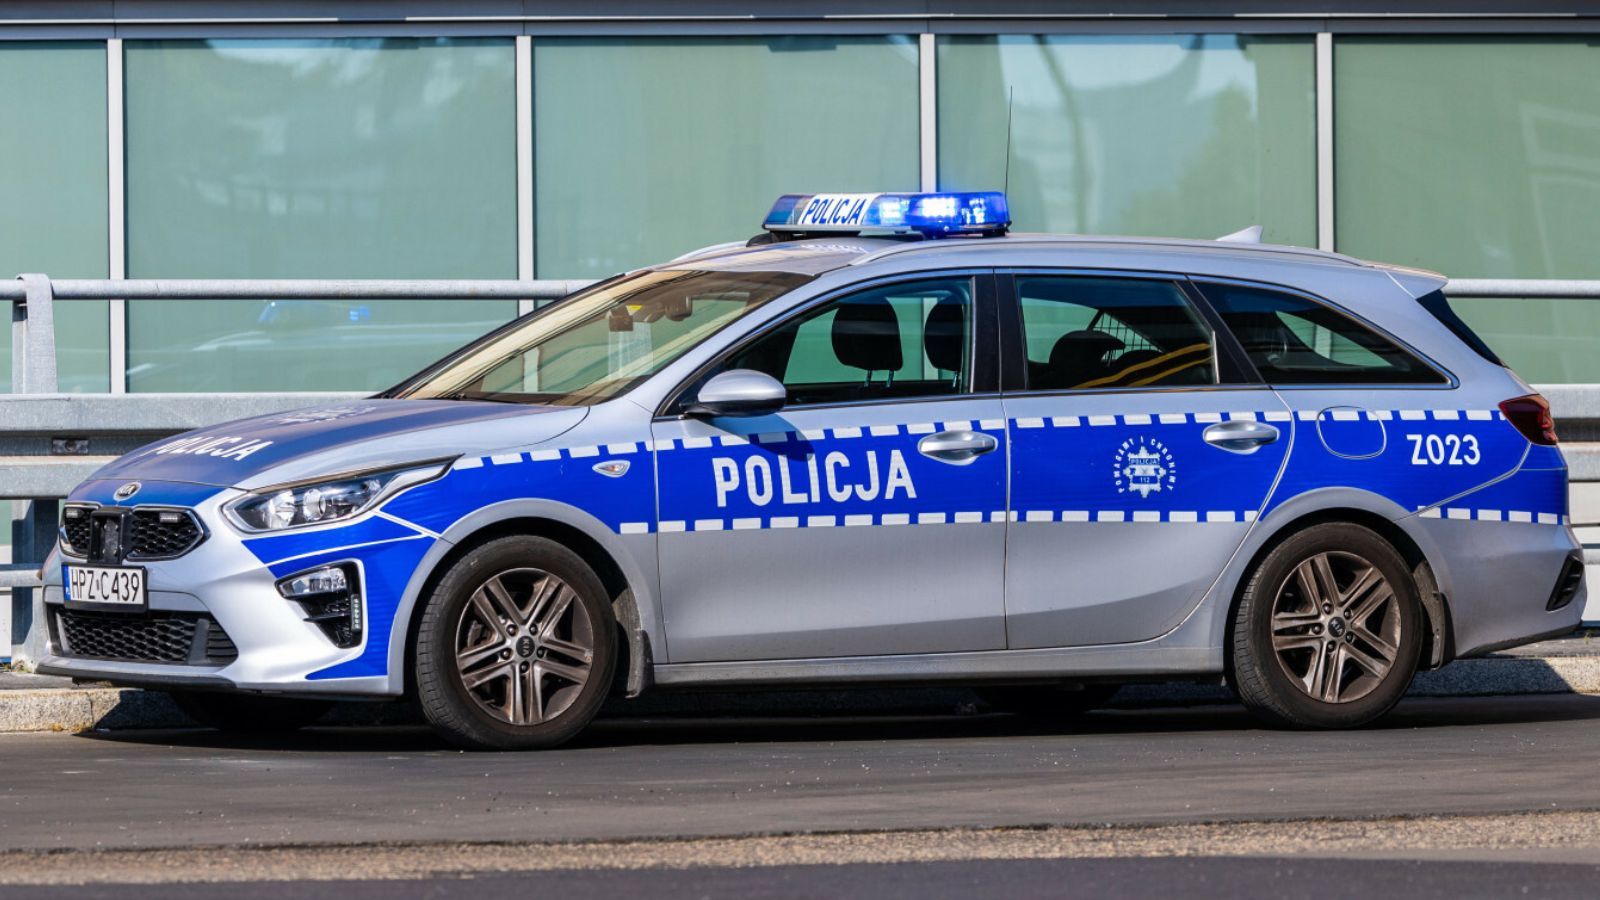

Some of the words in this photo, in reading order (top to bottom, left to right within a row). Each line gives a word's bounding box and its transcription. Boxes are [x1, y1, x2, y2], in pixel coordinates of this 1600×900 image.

[801, 198, 866, 224] POLICJA
[152, 436, 274, 461] OLICJA
[1406, 434, 1480, 465] Z023
[712, 449, 917, 507] POLICJA
[71, 569, 95, 600] HPZ
[101, 571, 140, 602] C439
